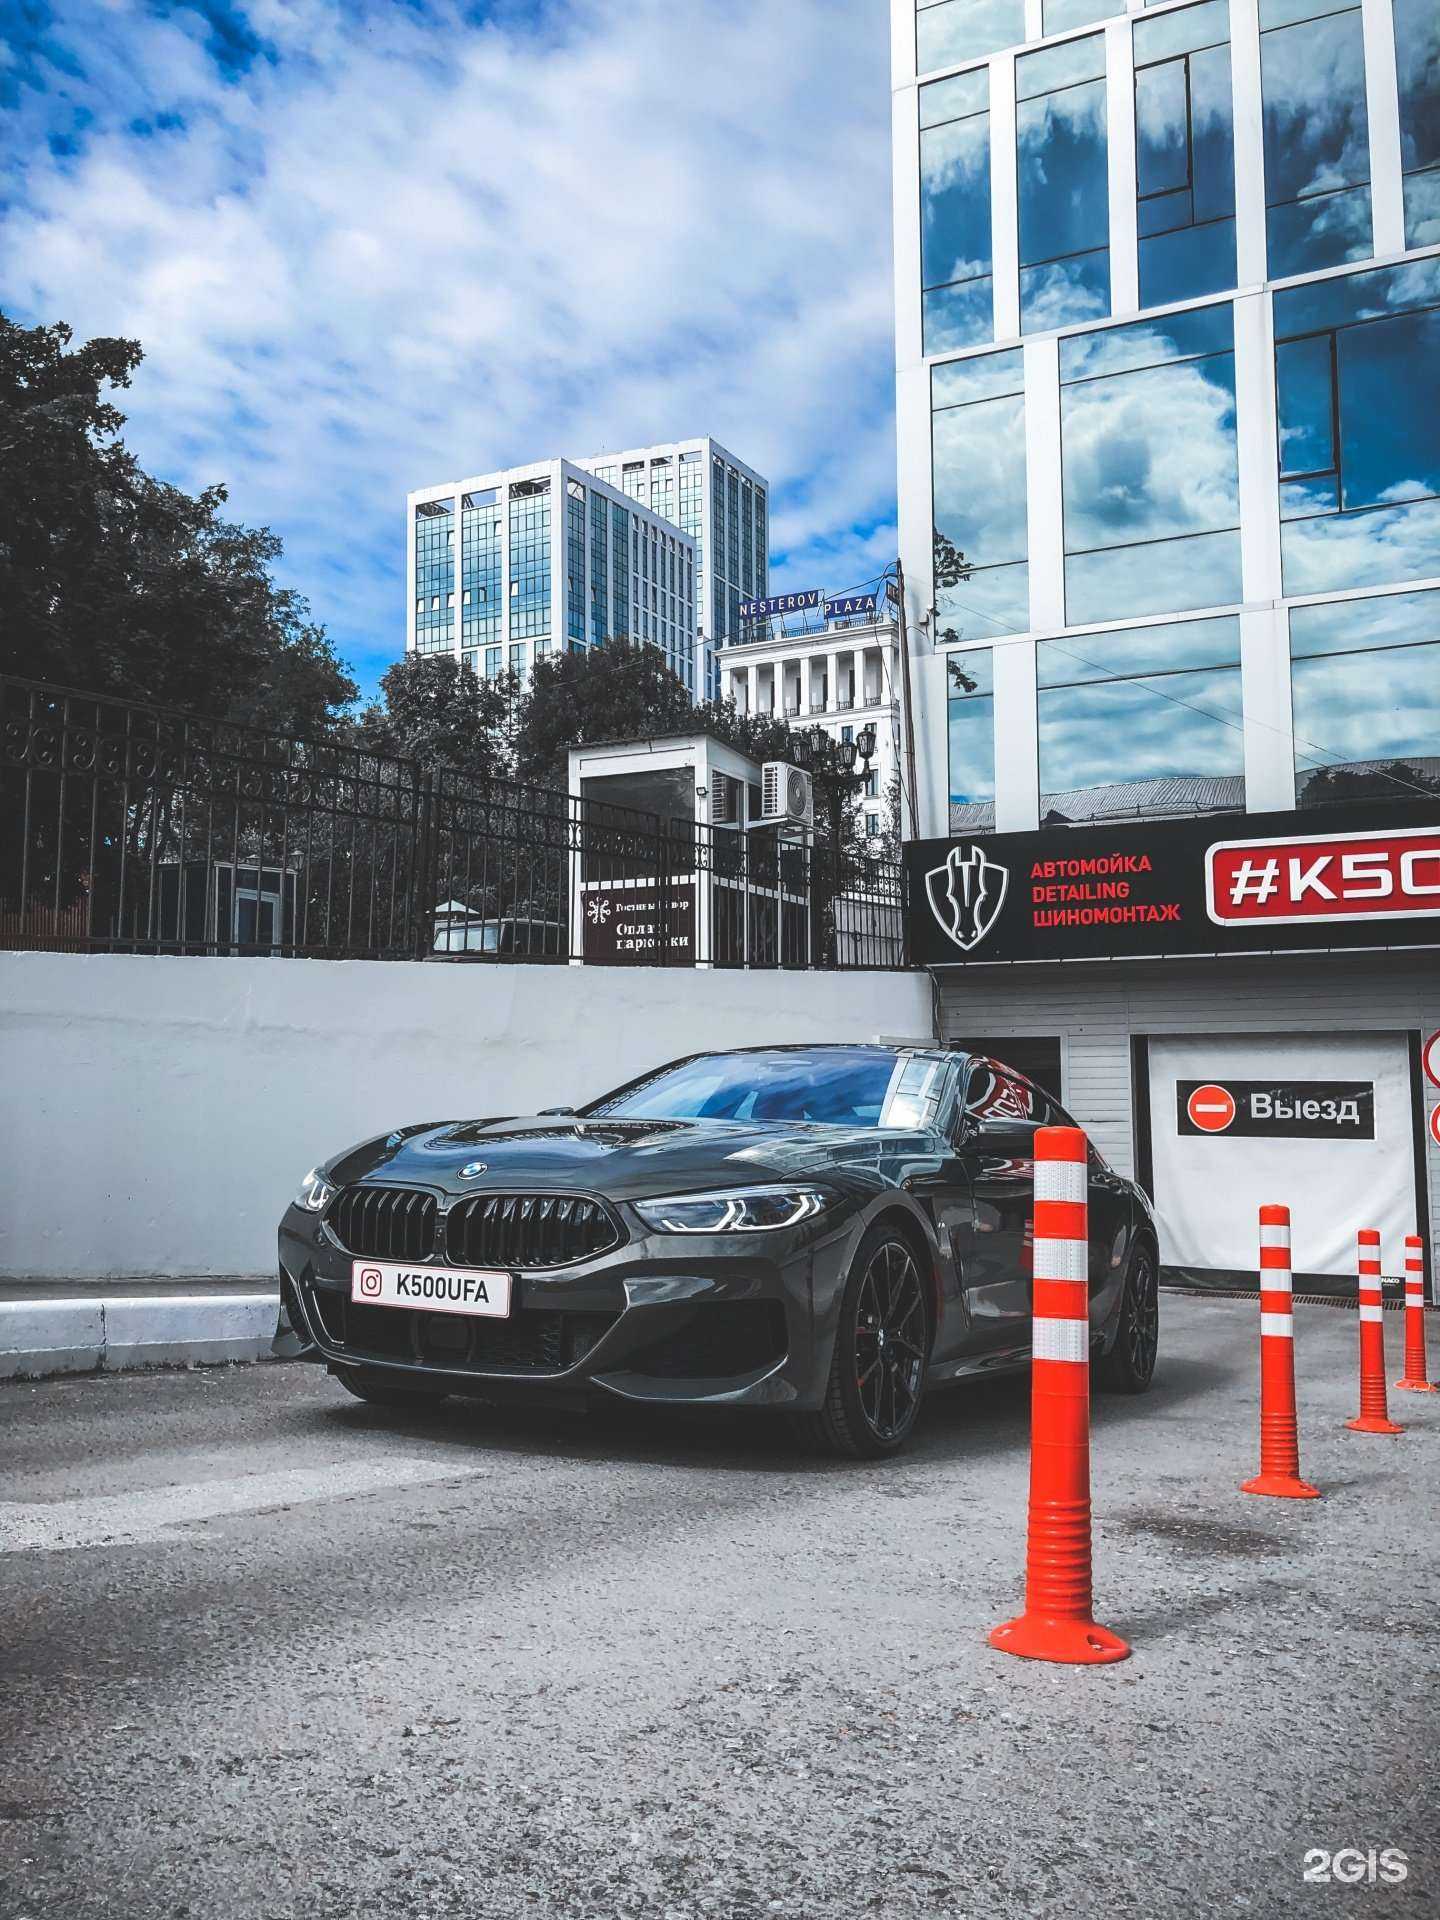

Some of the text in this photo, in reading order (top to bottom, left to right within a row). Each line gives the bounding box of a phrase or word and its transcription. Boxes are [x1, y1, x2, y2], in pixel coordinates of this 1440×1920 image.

[740, 593, 874, 616] NESTEROV PLAZA
[1030, 852, 1152, 879] АВТОМОЙКА
[1032, 881, 1131, 903] DETAILING
[1033, 903, 1182, 928] ШИНОМОНТАЖ
[616, 923, 668, 936] Опла
[1250, 1093, 1360, 1124] Выезд
[396, 1273, 490, 1304] K500UFA
